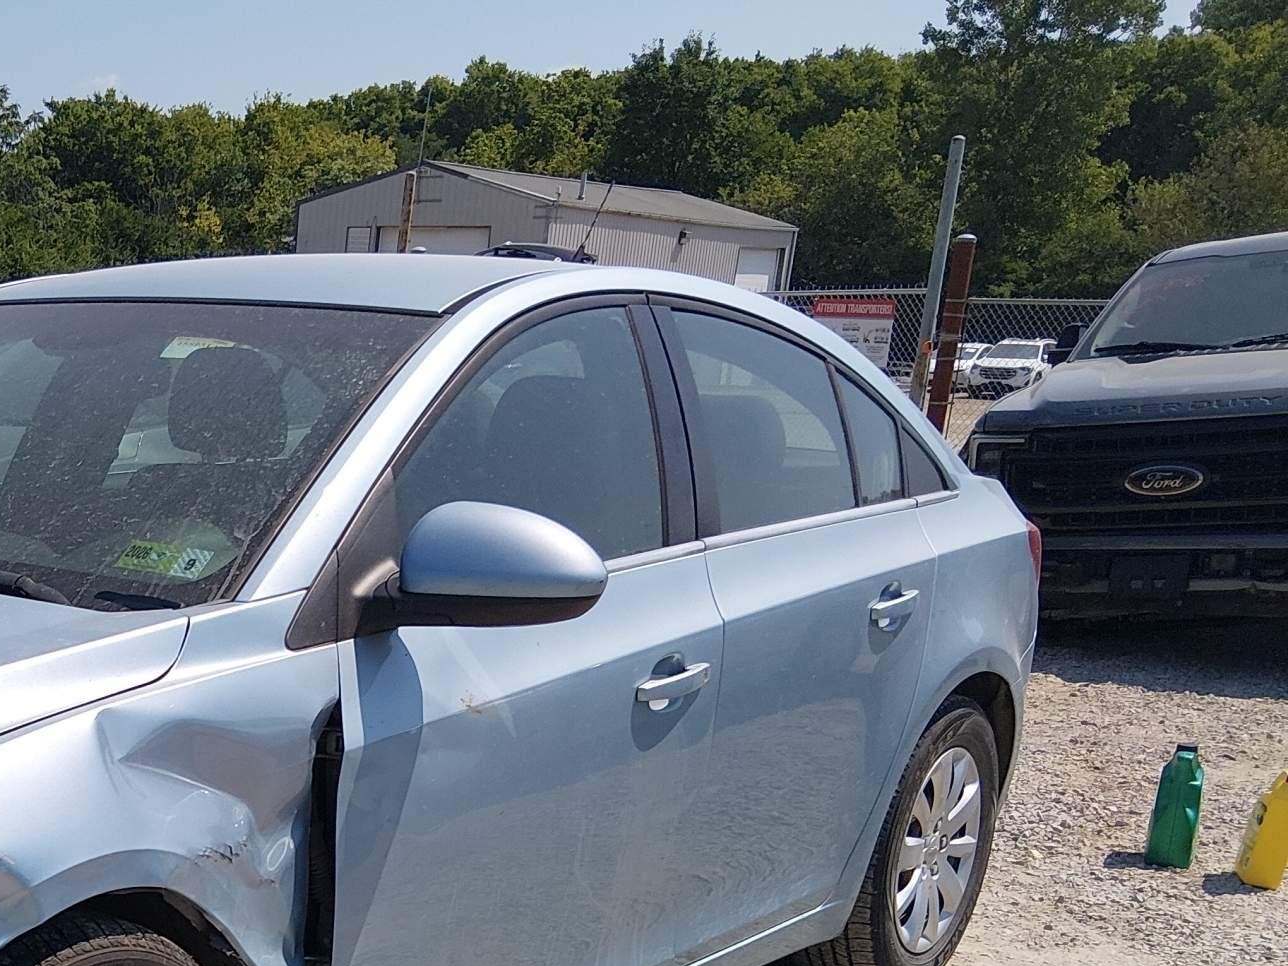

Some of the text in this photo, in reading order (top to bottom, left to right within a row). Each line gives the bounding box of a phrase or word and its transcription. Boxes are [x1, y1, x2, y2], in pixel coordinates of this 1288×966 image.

[816, 302, 847, 313] ATTENTION
[1187, 395, 1283, 411] DUTY
[1141, 471, 1184, 489] Ford
[183, 558, 197, 571] 9
